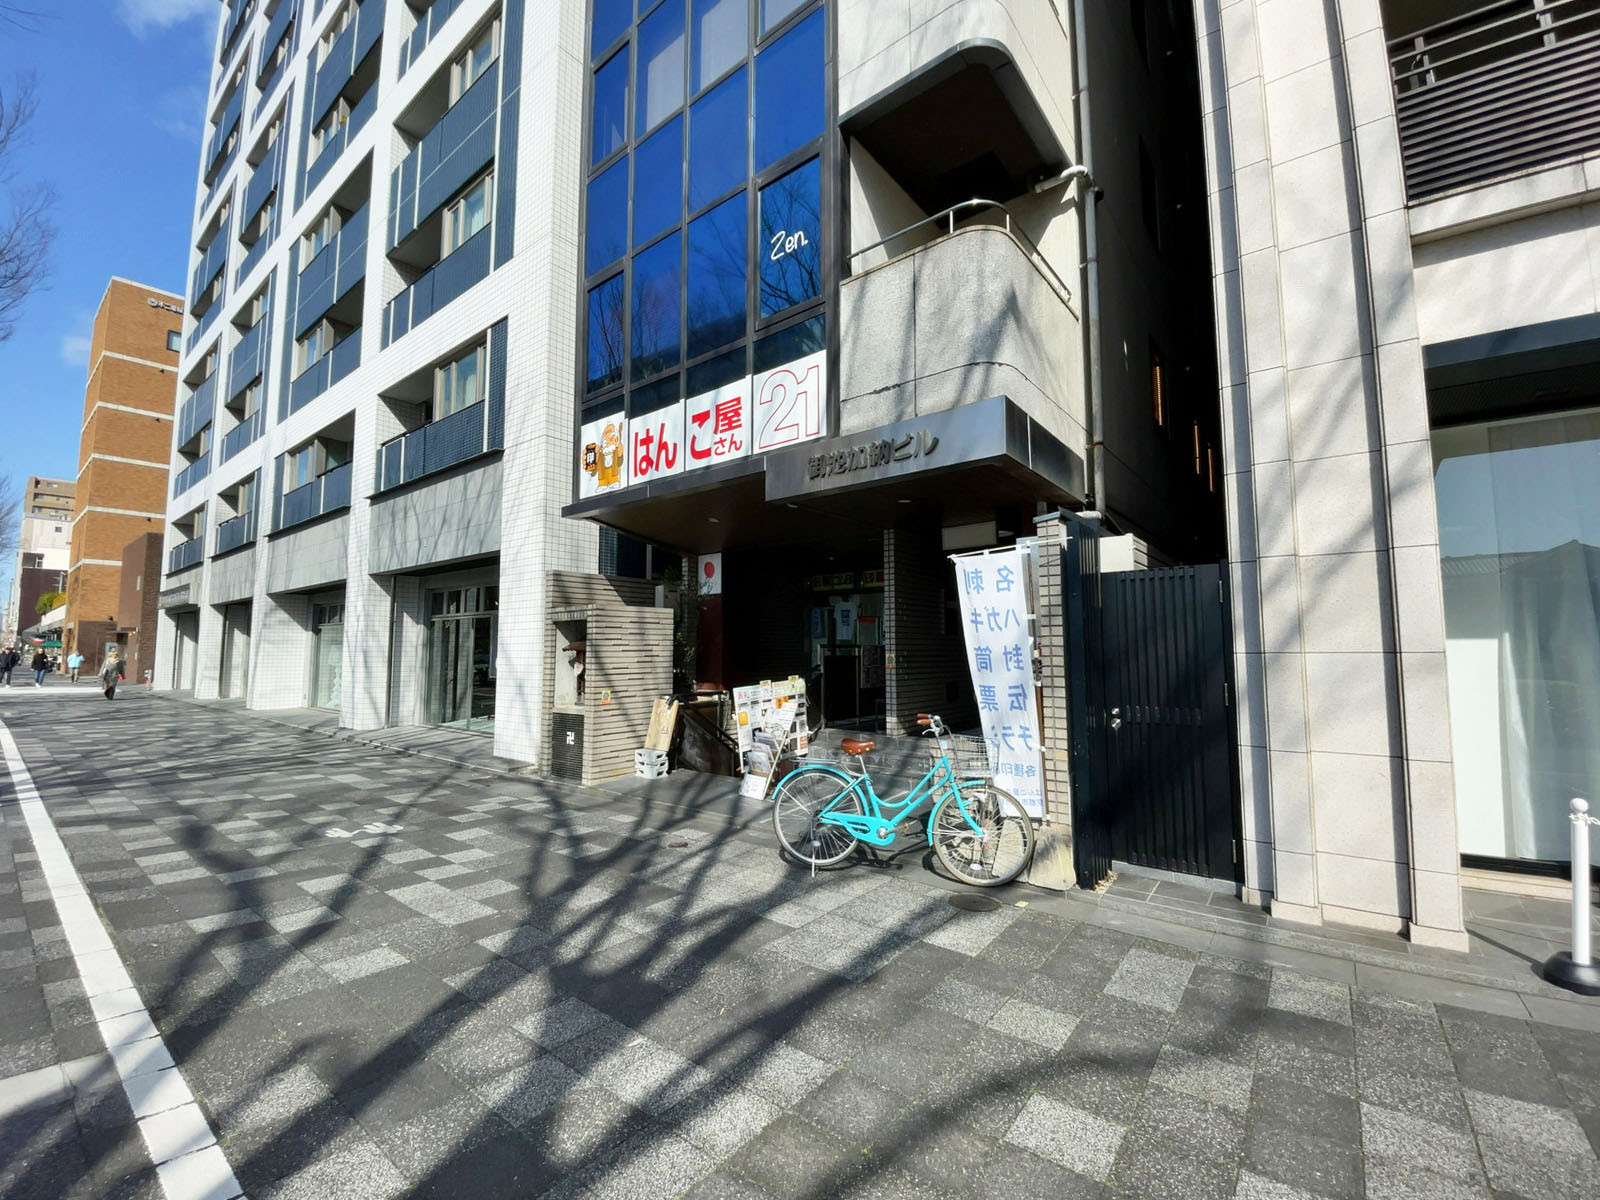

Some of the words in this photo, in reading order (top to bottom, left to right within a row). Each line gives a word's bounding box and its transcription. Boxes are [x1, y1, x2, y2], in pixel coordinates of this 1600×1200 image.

[758, 364, 820, 450] 21
[808, 430, 939, 480] 御池加納ビル
